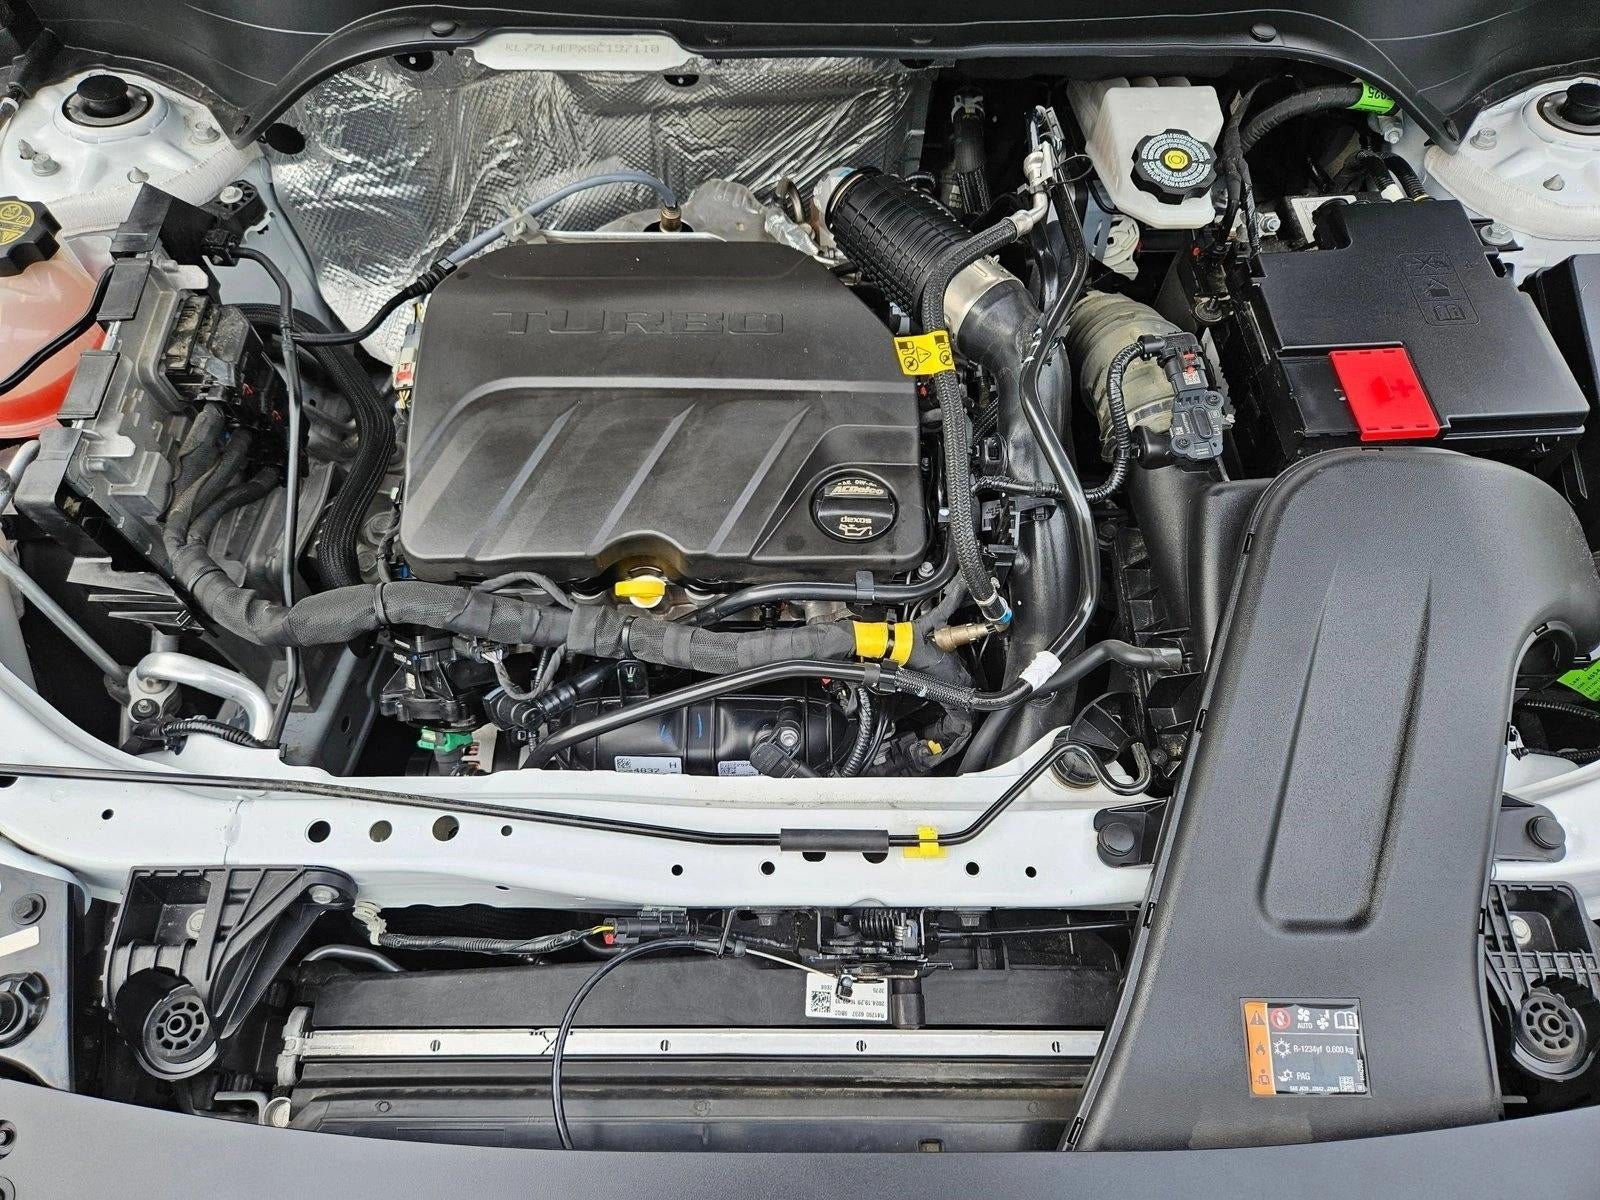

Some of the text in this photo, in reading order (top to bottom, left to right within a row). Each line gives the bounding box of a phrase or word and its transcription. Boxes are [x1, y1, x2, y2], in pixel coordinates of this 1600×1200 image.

[492, 310, 784, 335] TURBO
[840, 515, 872, 524] dexos
[1297, 1022, 1313, 1030] AUTO
[1293, 1044, 1354, 1055] R-1234yf 0.600 kg
[1296, 1072, 1311, 1081] PAG
